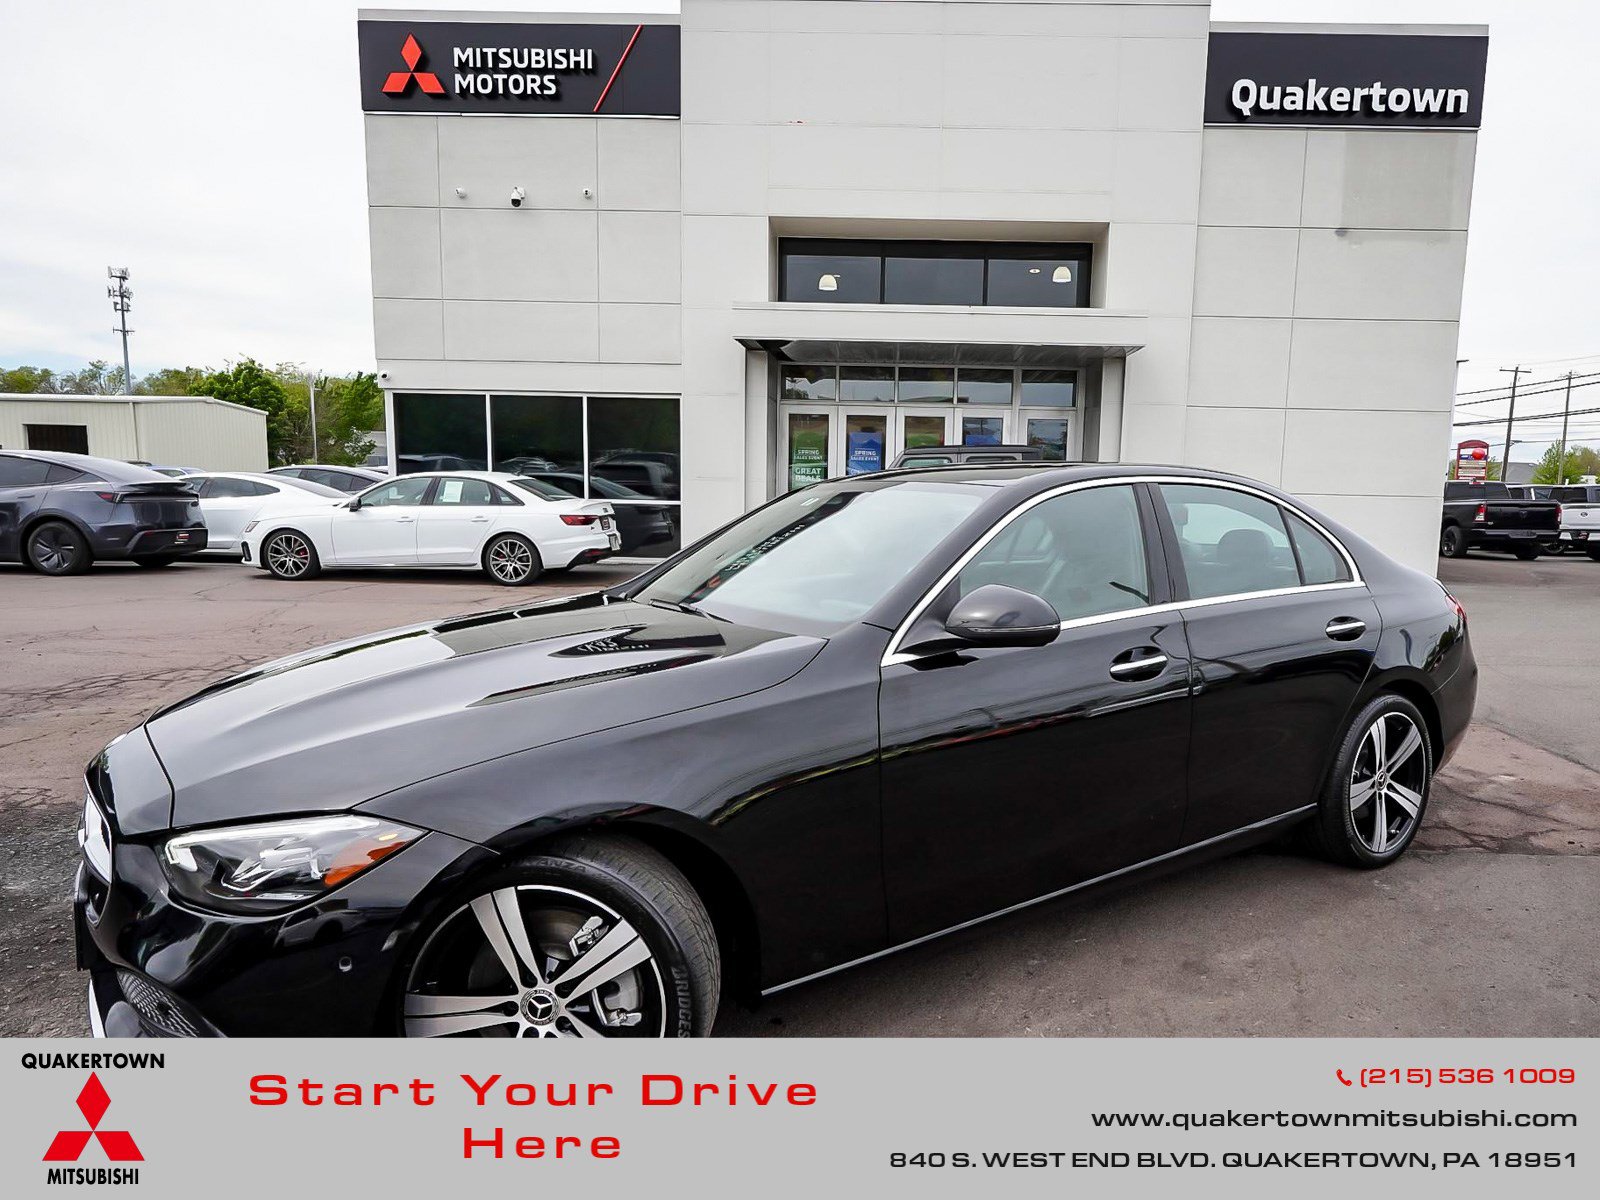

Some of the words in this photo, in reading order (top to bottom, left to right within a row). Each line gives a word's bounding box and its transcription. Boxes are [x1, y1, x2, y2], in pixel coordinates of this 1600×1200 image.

[453, 48, 593, 70] MITSUBISHI
[454, 73, 557, 95] MOTORS
[1231, 78, 1470, 116] Quakertown
[795, 467, 822, 475] GREAT
